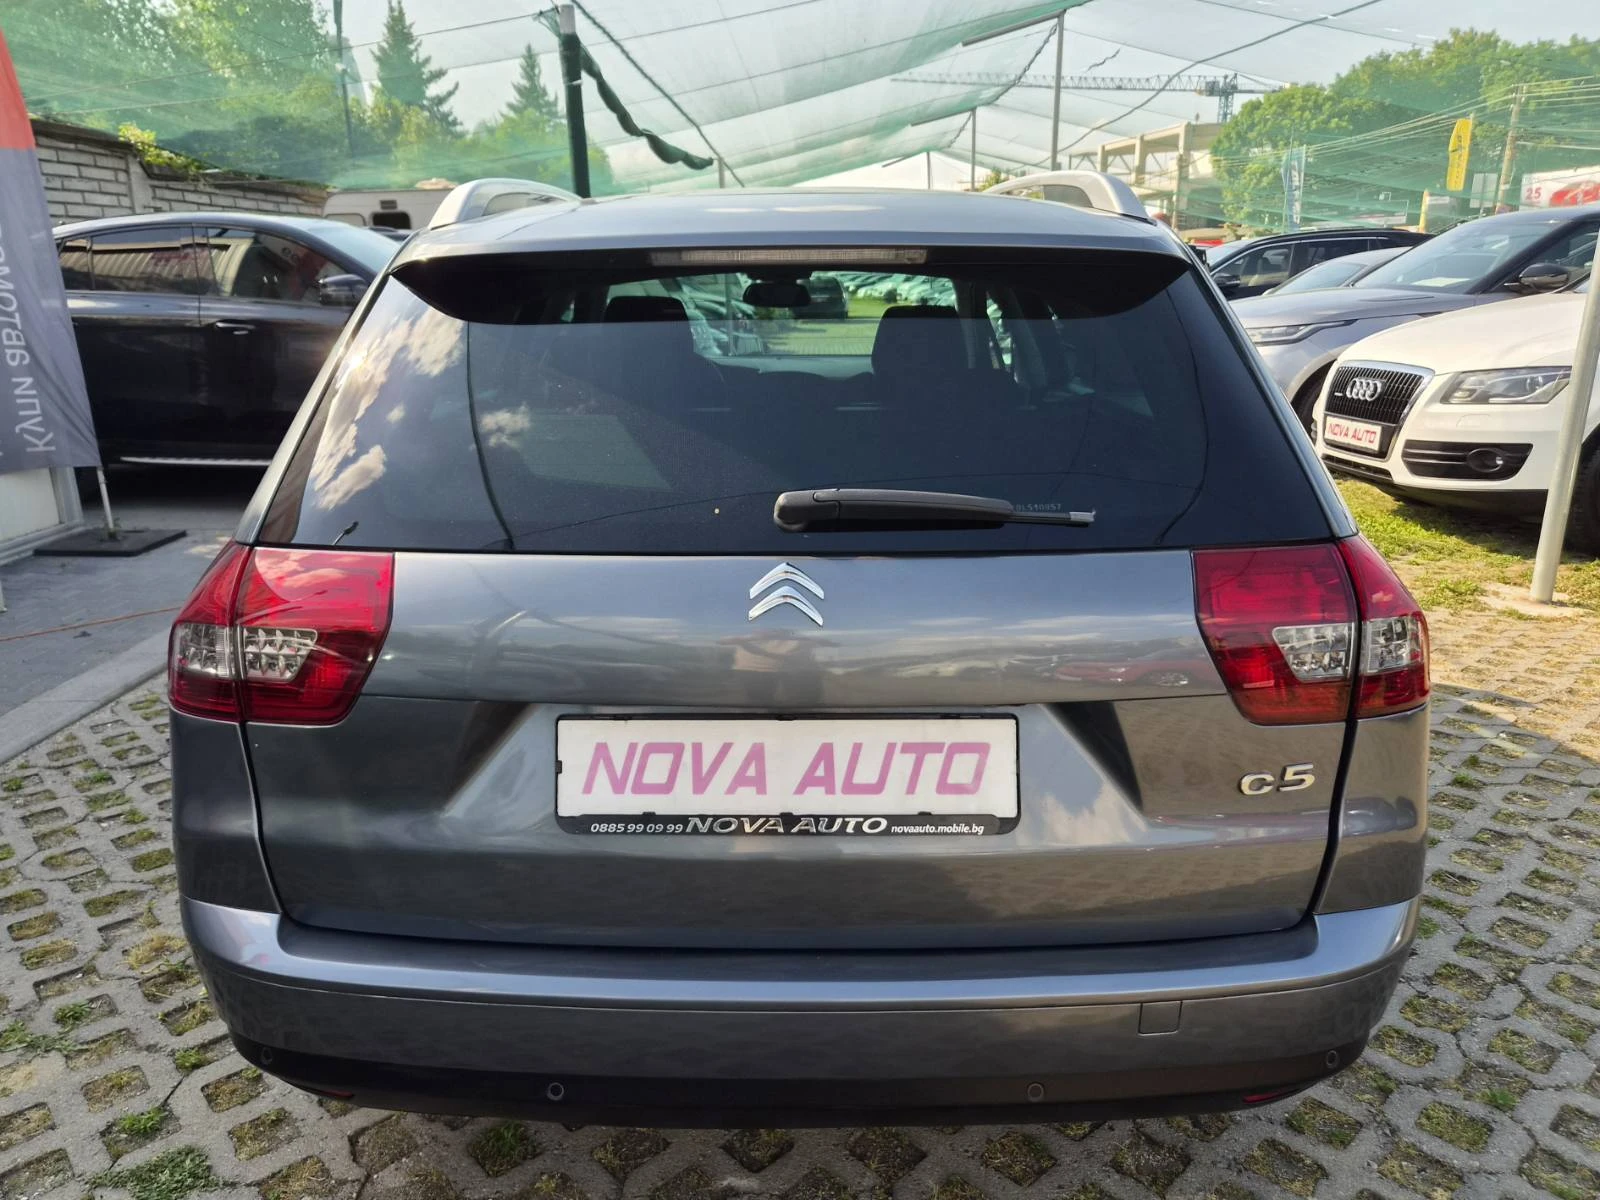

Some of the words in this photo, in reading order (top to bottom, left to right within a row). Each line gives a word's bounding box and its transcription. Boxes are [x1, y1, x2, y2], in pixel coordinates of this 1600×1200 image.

[1328, 423, 1349, 438] NOVA
[1351, 428, 1377, 444] AUTO
[582, 742, 767, 795] NOVA
[793, 742, 991, 795] AUTO
[1238, 763, 1315, 795] C5
[590, 823, 625, 833] 0885
[626, 823, 644, 833] 99
[646, 823, 664, 833] 09
[665, 823, 683, 833] 99
[685, 817, 785, 833] NOVA
[791, 817, 888, 834] AUTO
[891, 823, 985, 835] novaauto.mobile.bg
